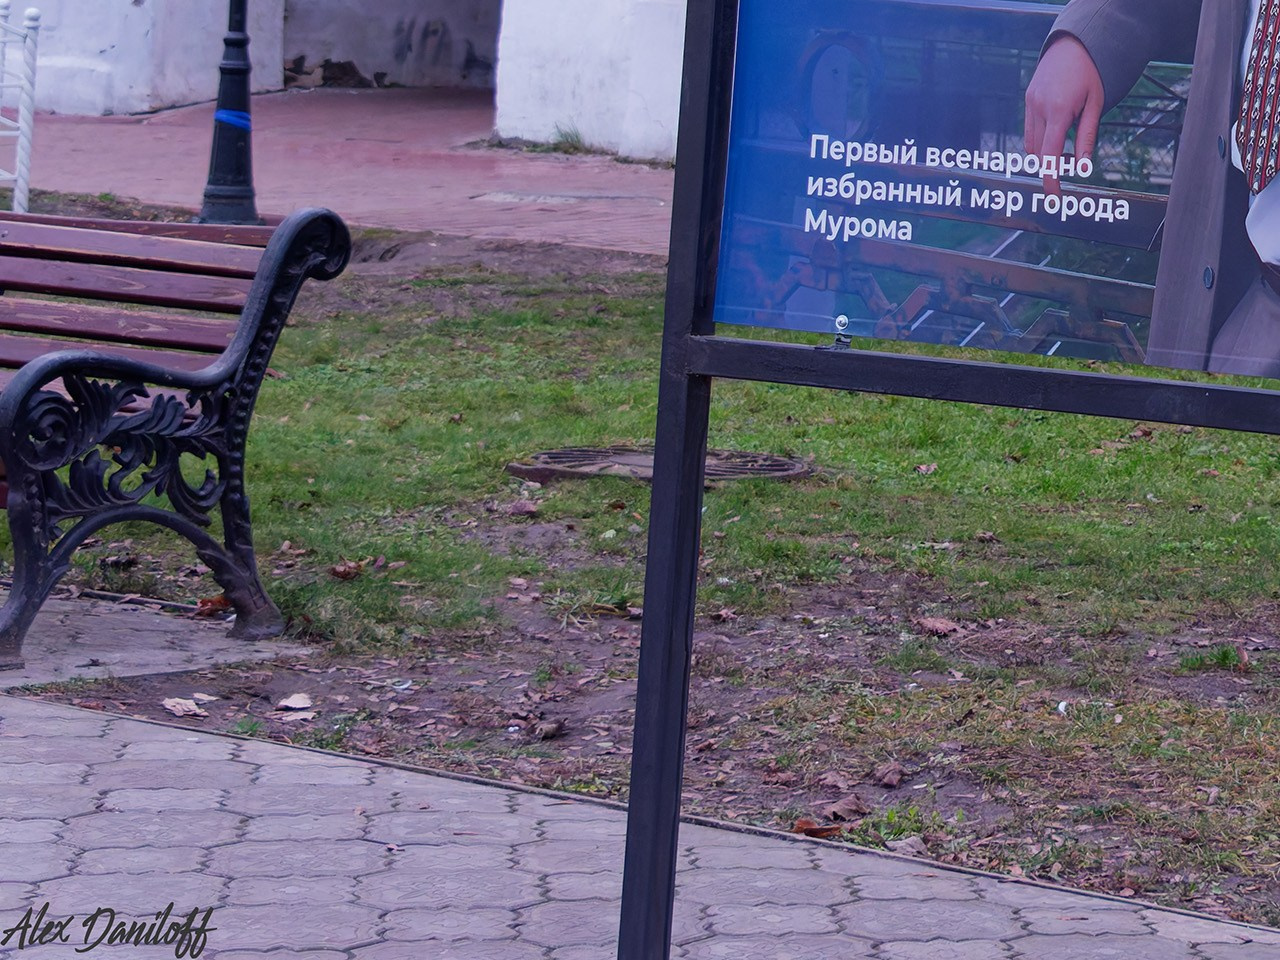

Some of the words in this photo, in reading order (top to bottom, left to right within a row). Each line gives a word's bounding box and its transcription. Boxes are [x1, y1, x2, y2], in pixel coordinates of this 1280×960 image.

[810, 134, 918, 167] Первый
[925, 150, 1093, 180] всенародно
[806, 172, 962, 207] избранный
[970, 189, 1024, 217] мэр
[1031, 193, 1130, 223] города
[804, 208, 912, 242] Мурома
